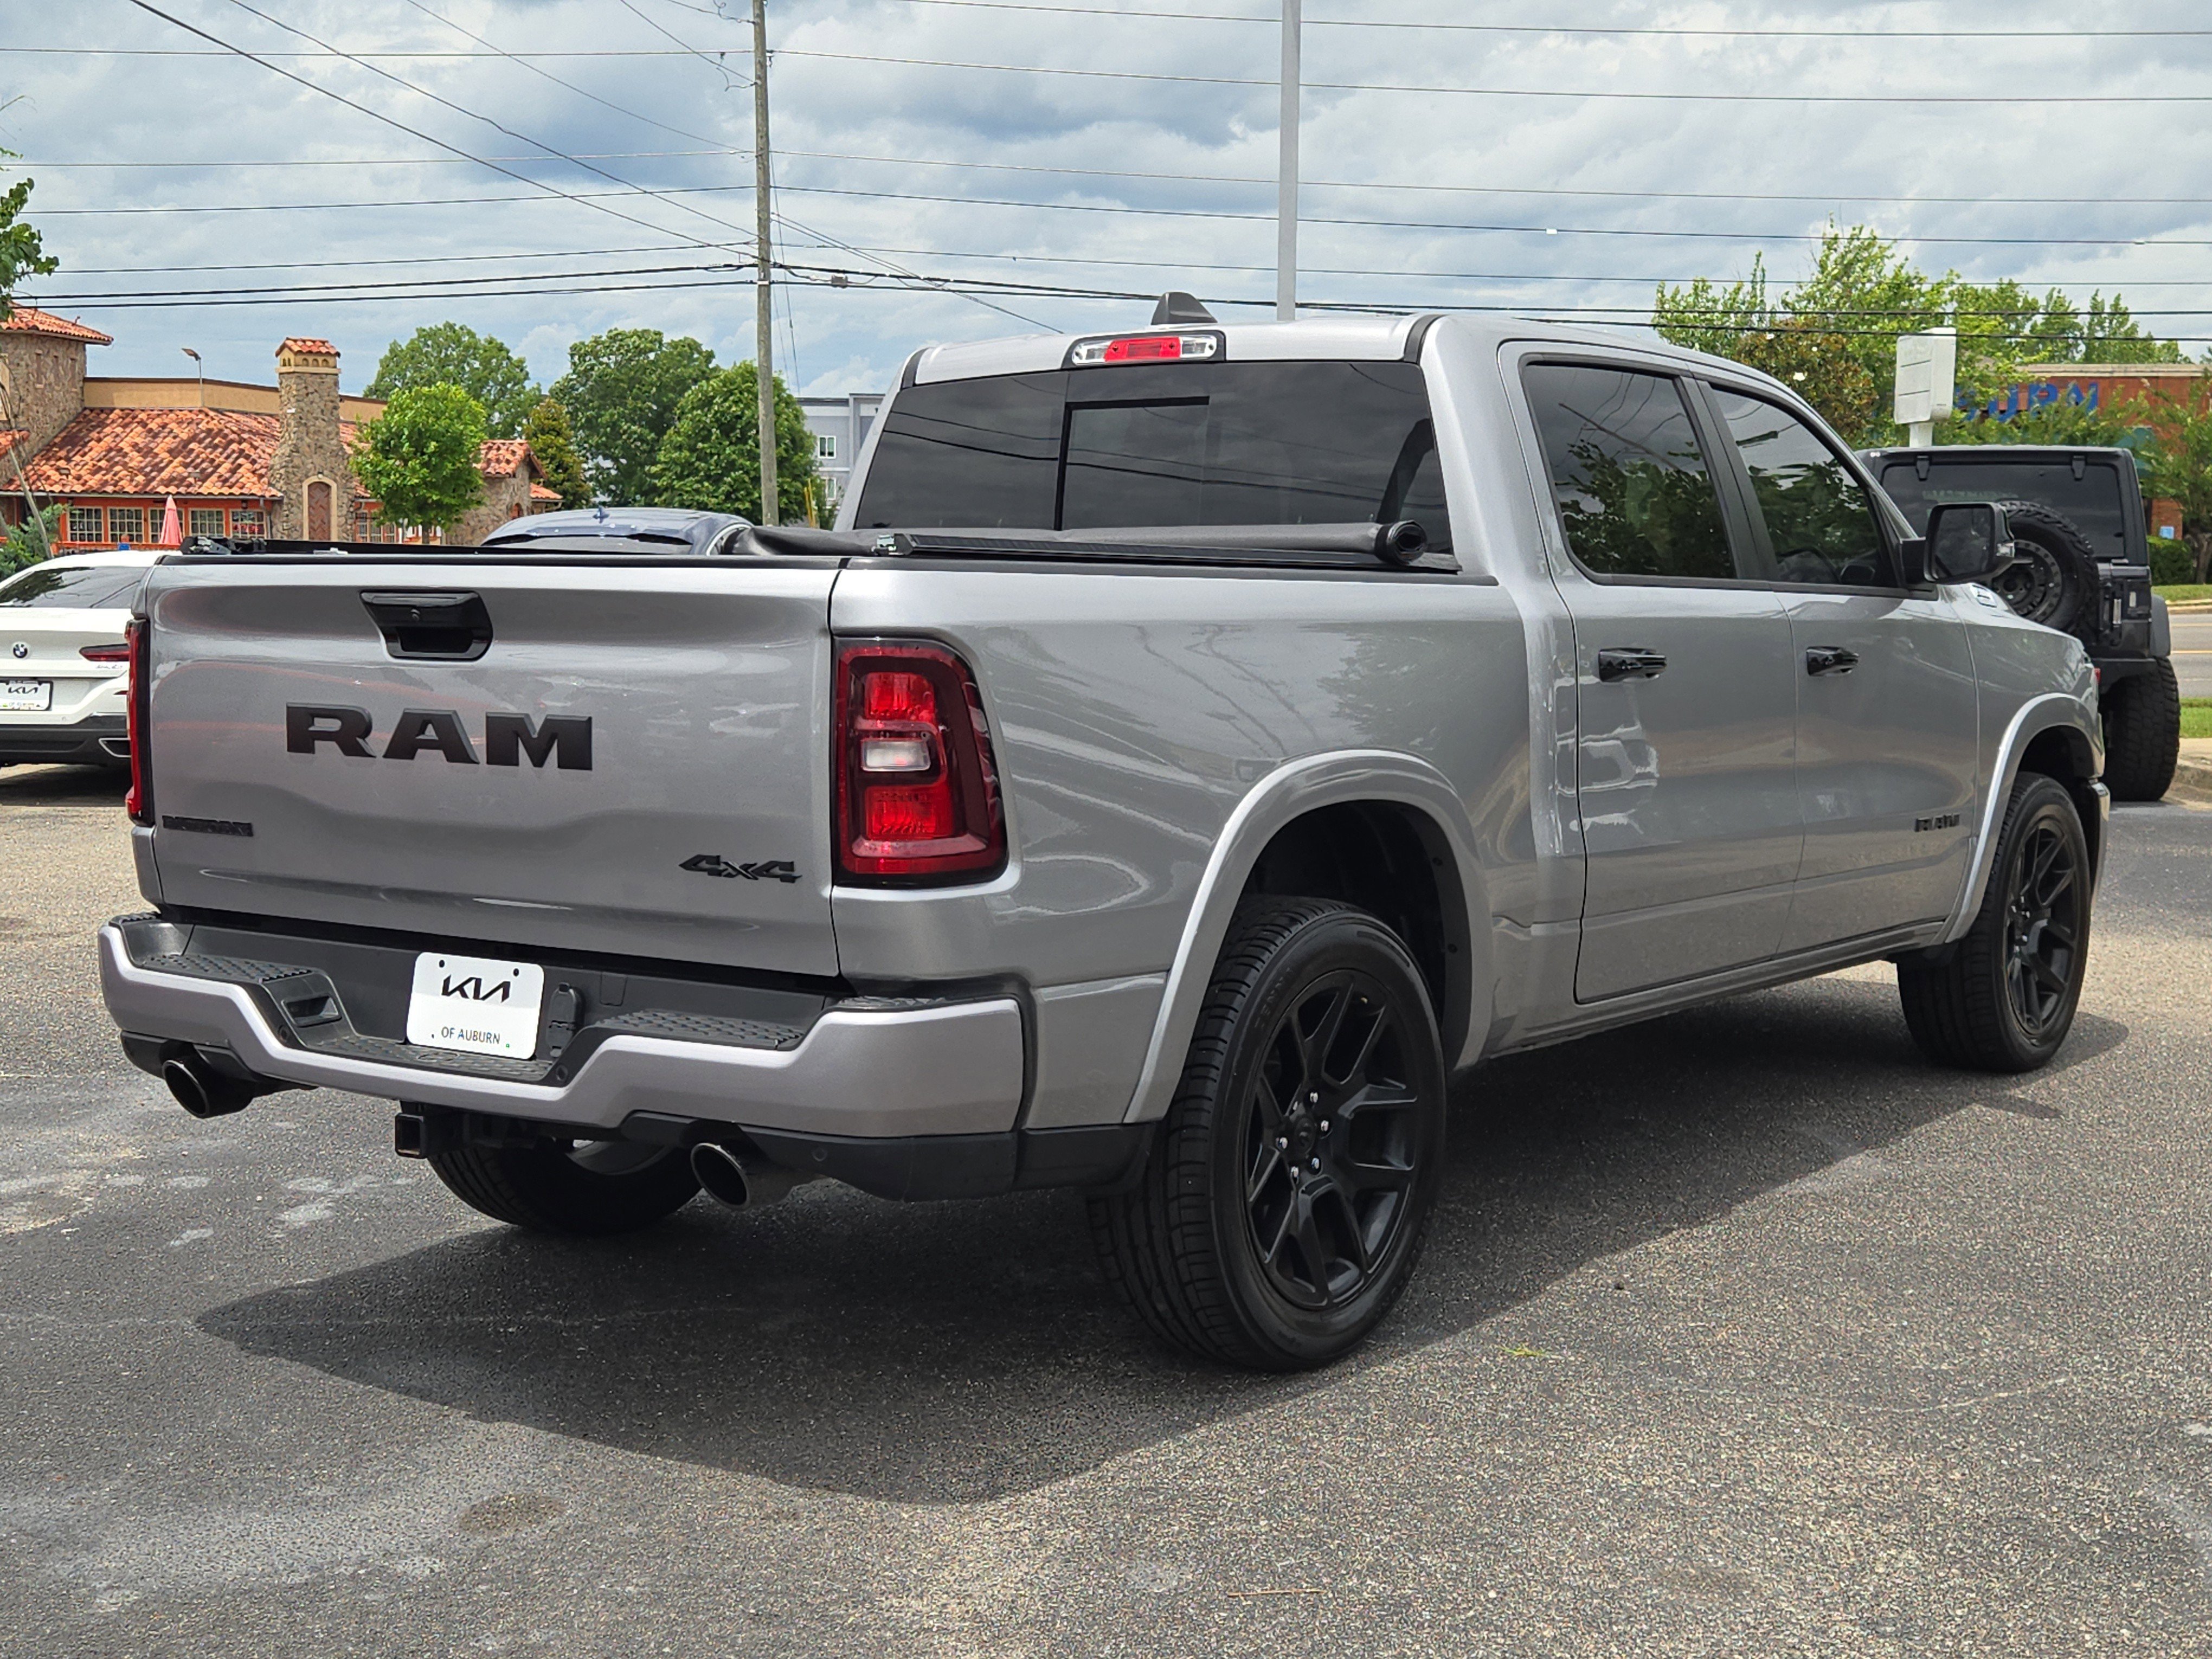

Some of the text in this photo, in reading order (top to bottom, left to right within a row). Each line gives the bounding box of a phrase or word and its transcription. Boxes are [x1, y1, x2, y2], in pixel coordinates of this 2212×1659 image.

[286, 702, 592, 770] RAM
[441, 974, 511, 1003] KIA
[441, 1026, 500, 1044] OF AUBURN
